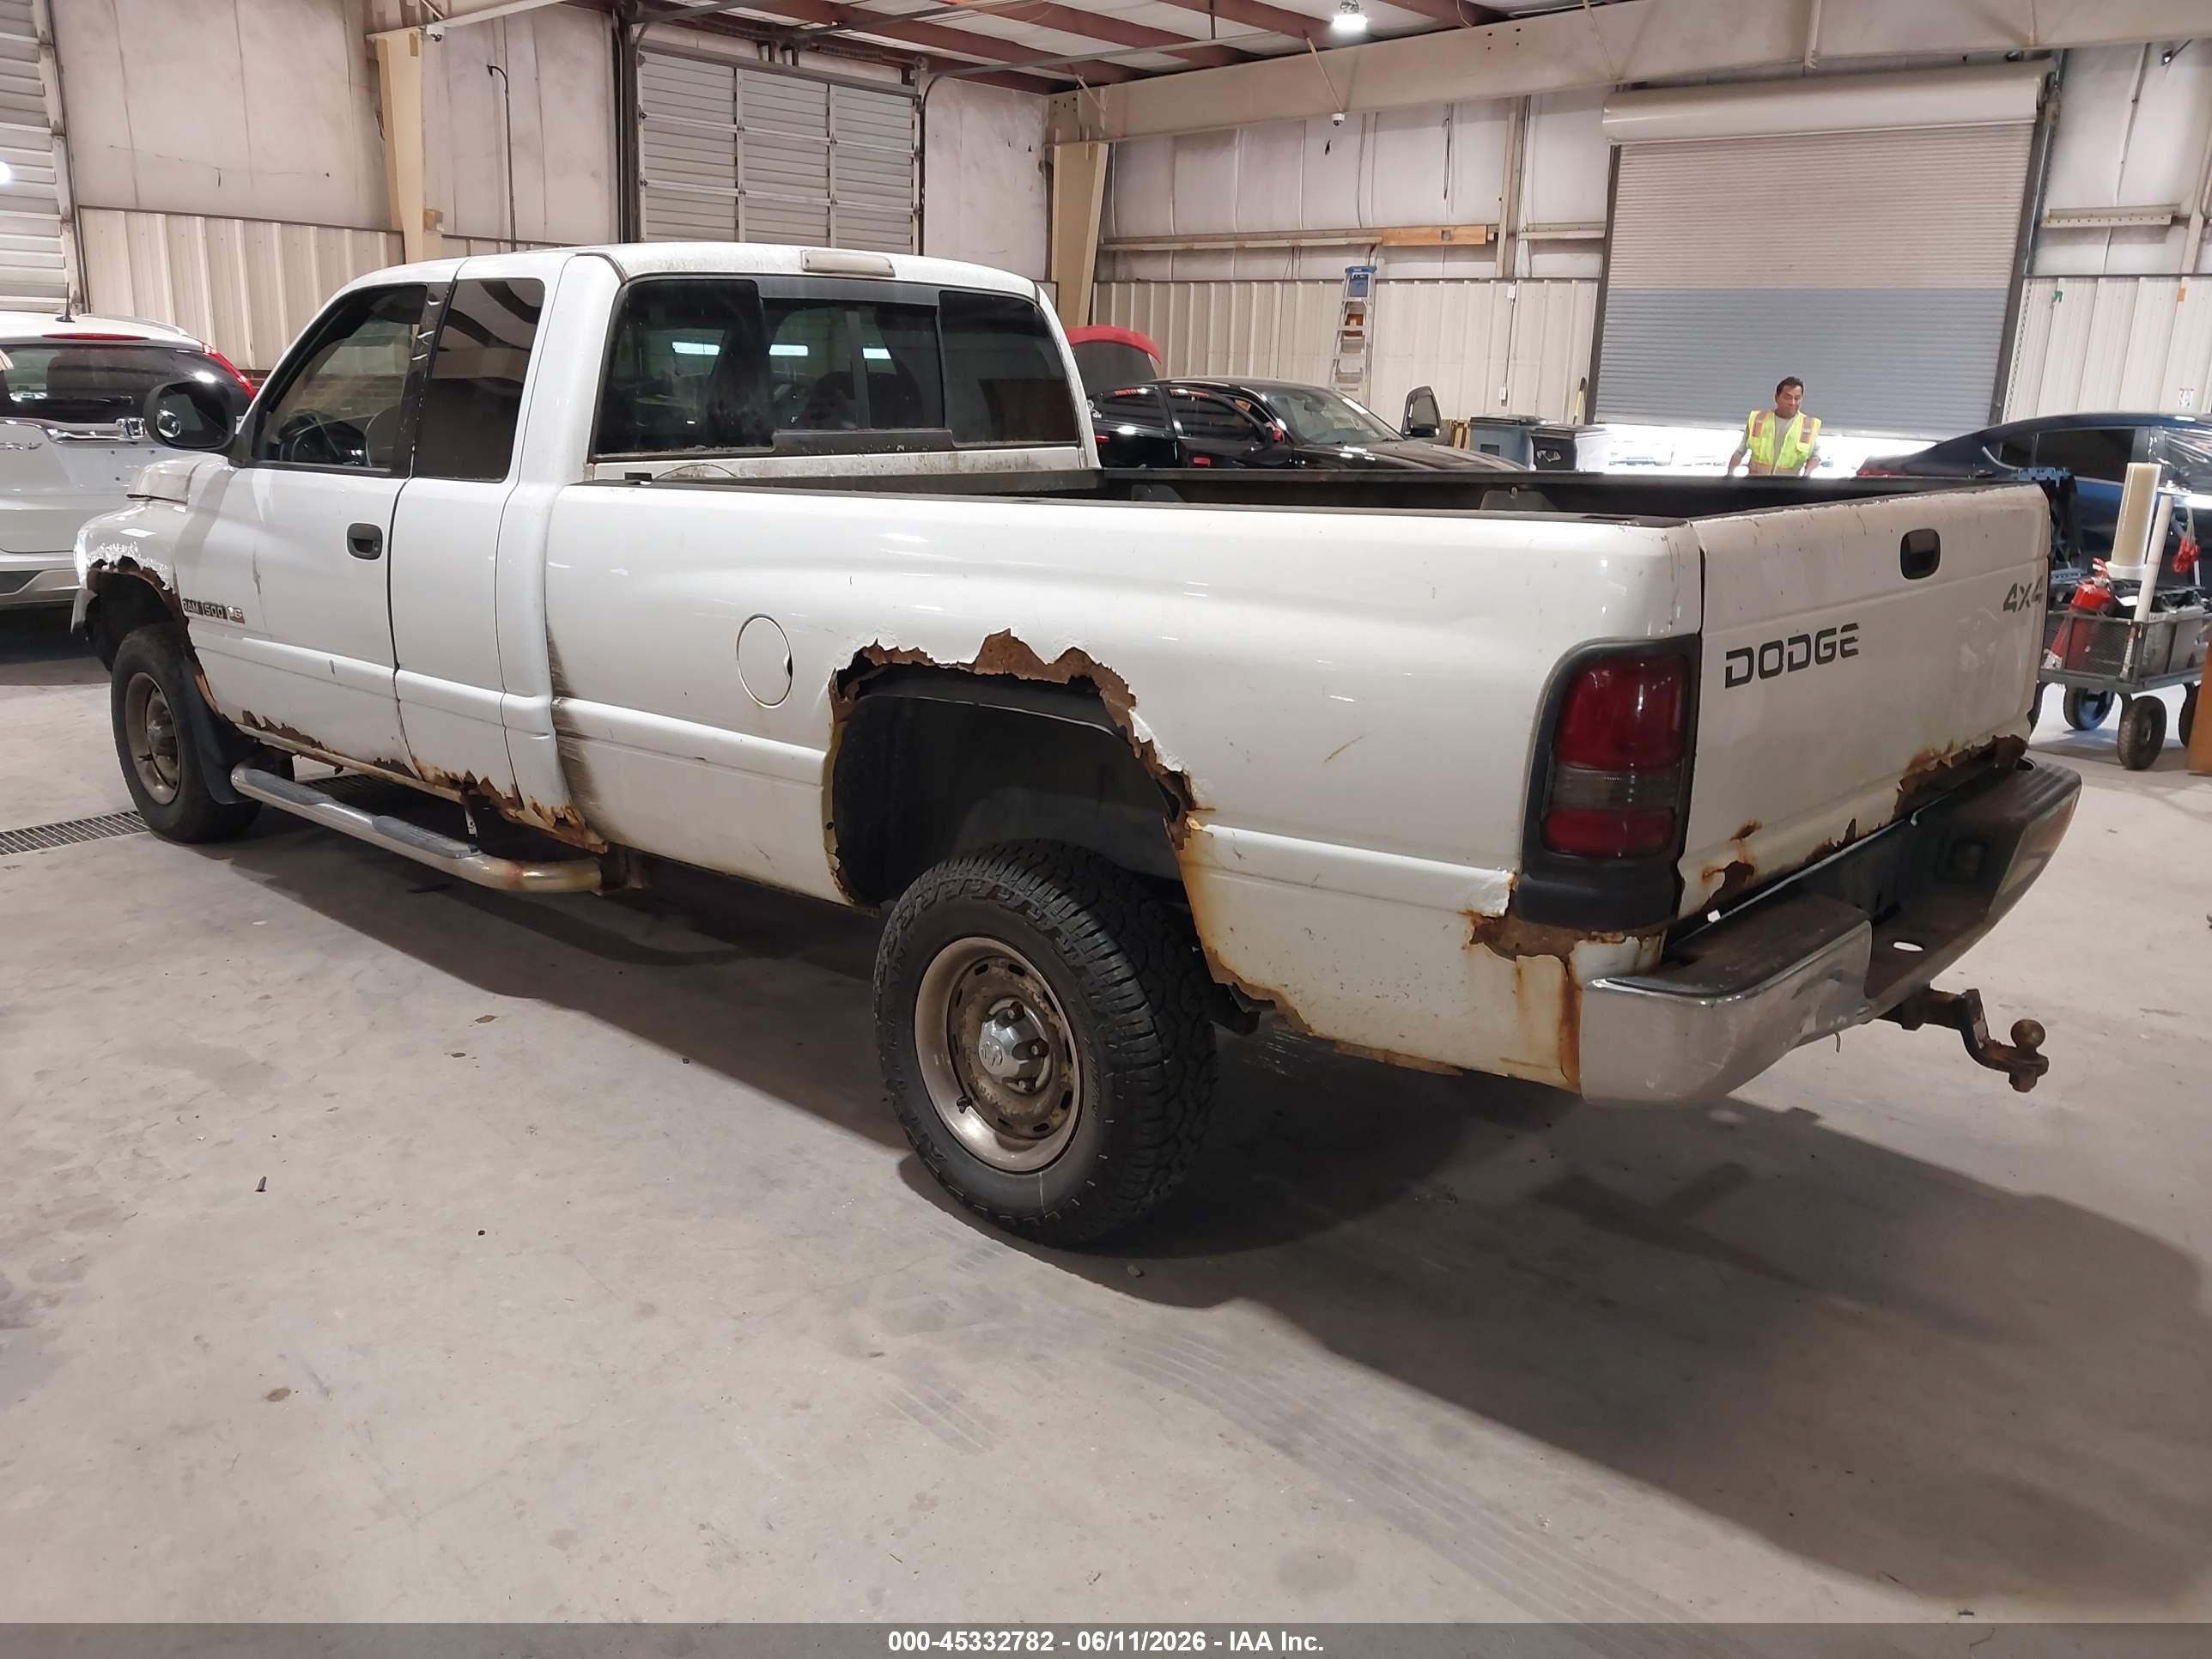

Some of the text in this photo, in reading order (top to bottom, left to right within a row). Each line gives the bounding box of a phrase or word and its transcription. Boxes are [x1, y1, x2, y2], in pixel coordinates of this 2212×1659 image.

[182, 600, 200, 612] RAM
[202, 602, 224, 617] 1500
[2002, 575, 2044, 613] 4X4
[1724, 623, 1859, 690] DODGE
